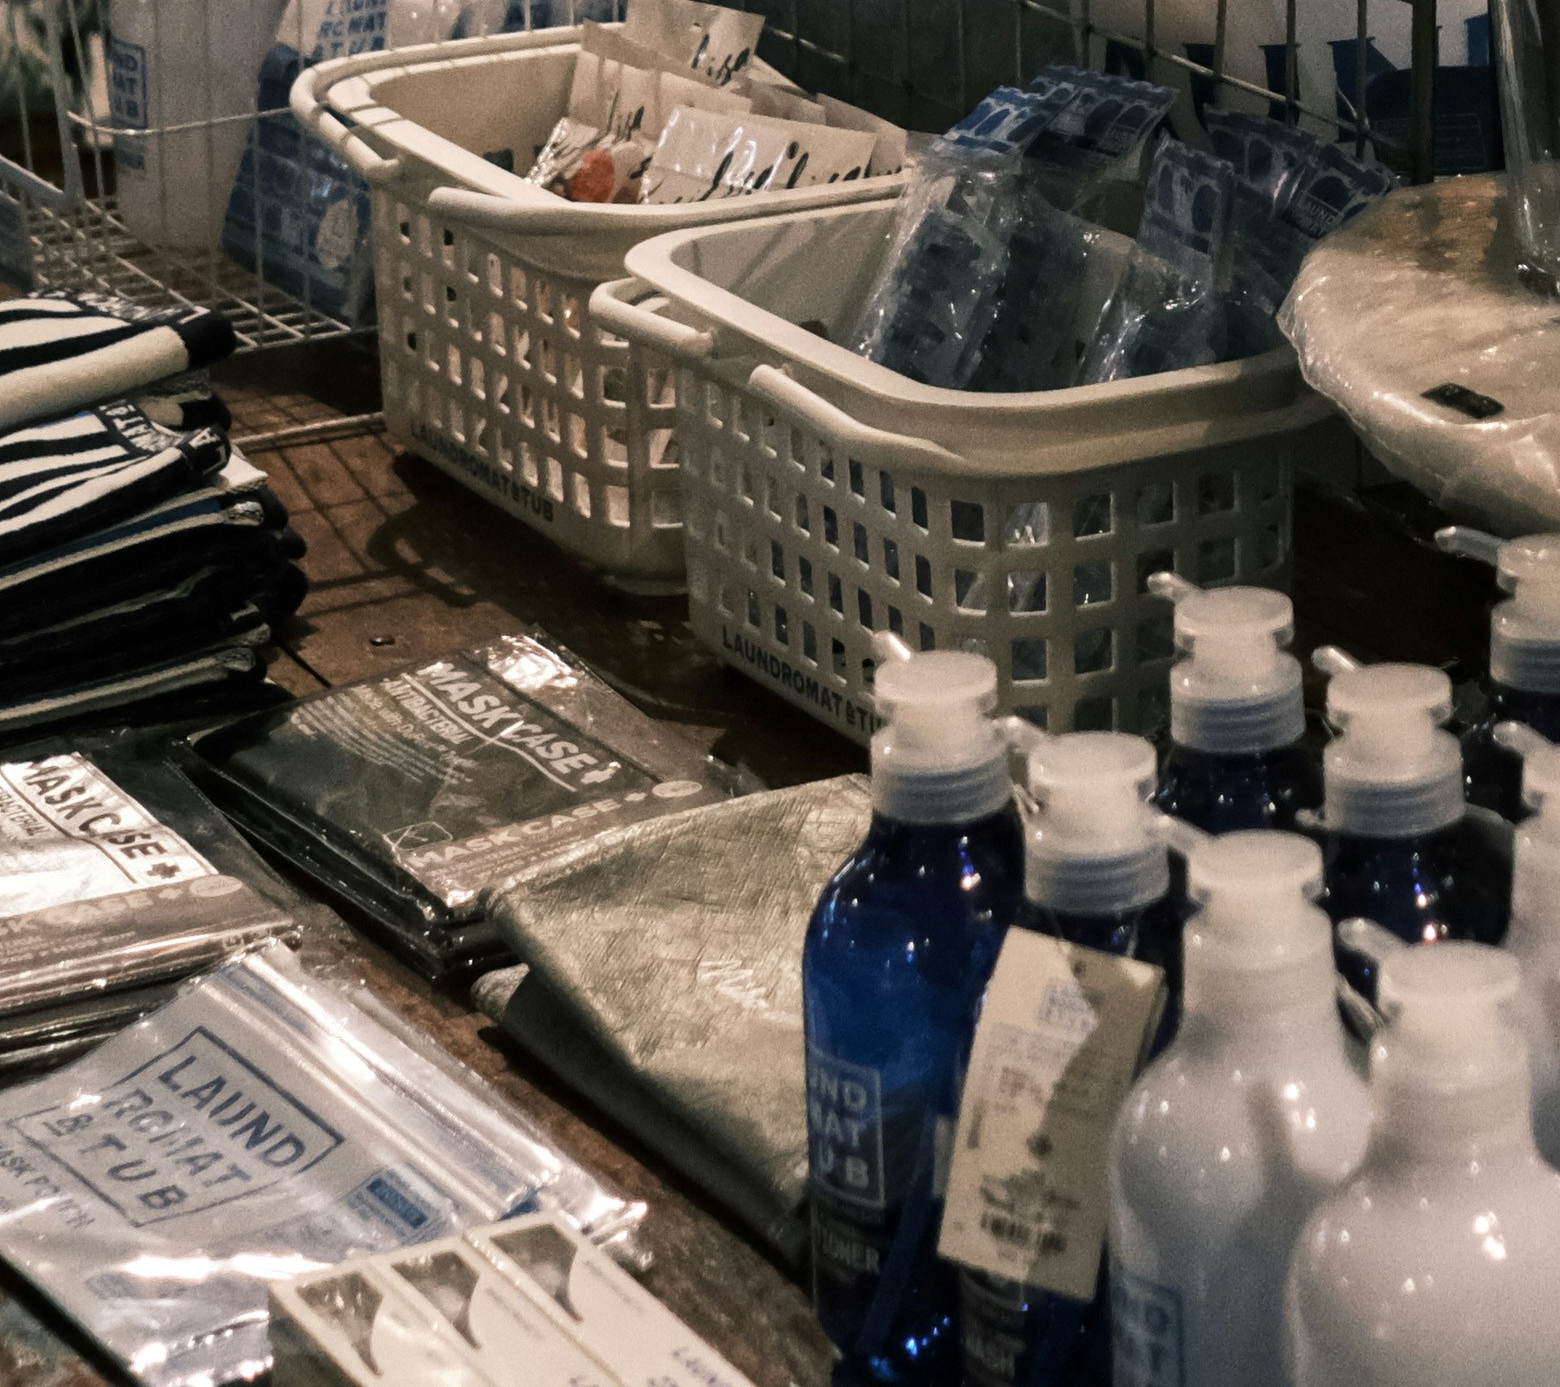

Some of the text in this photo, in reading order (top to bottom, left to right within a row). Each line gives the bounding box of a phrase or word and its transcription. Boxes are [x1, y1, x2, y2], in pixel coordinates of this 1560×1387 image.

[383, 677, 475, 745] ANTIBACTERIAL
[416, 661, 516, 729] MASK
[511, 720, 600, 776] CASE
[723, 625, 883, 733] LAUNDROMAT&TU
[407, 798, 623, 868] MASK CASE
[101, 1087, 252, 1189] ROMAT
[158, 1055, 307, 1169] LAUND
